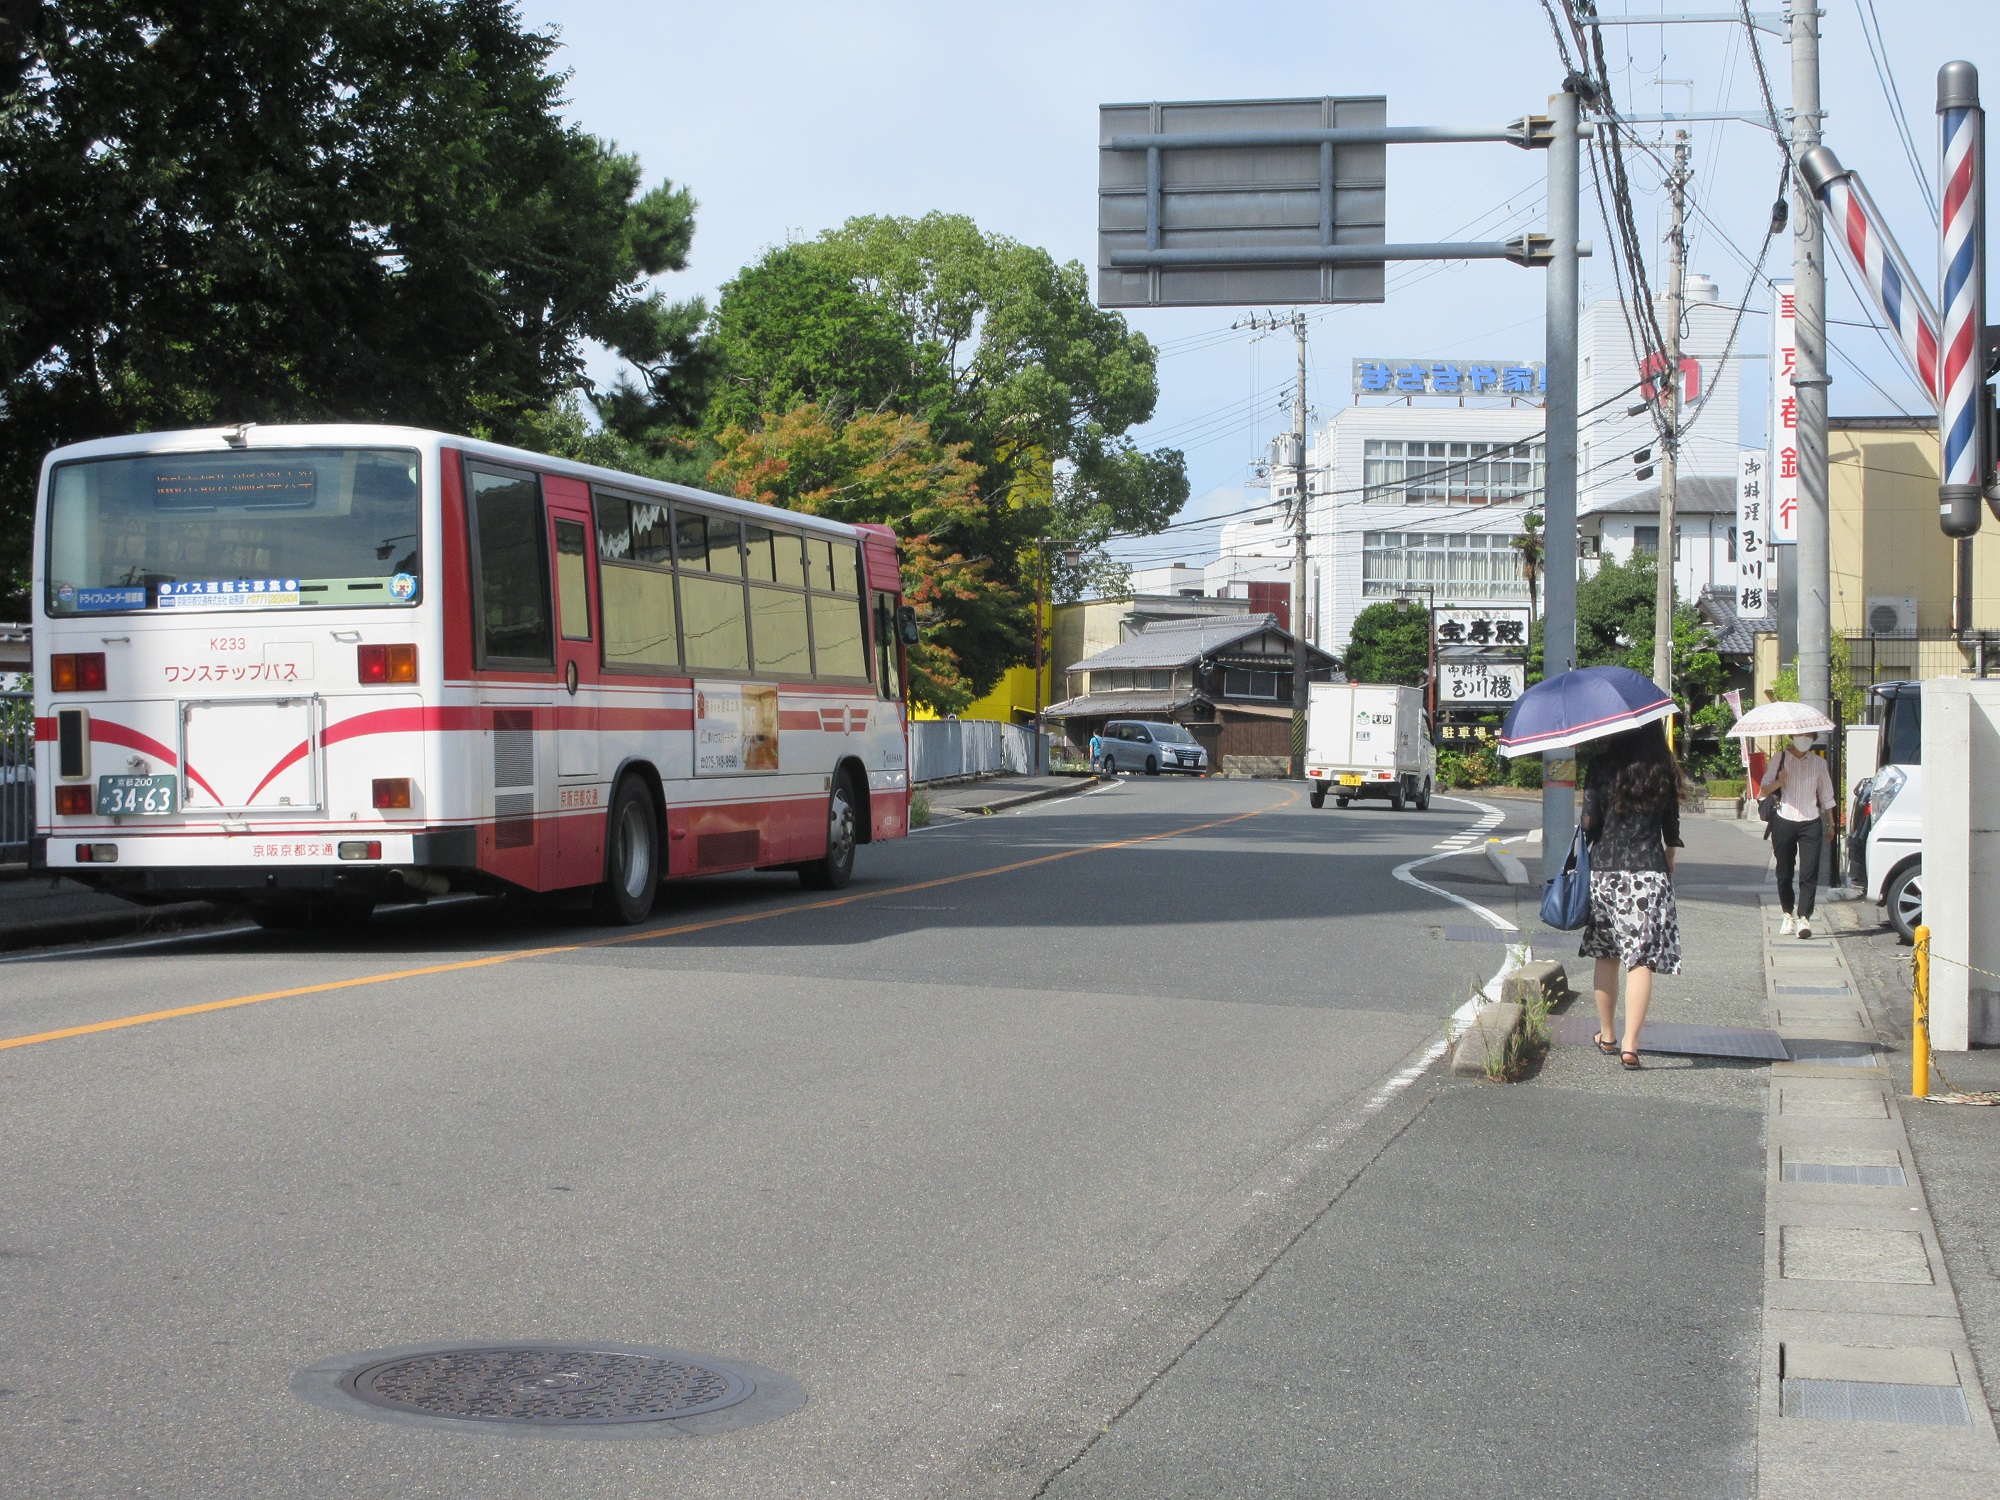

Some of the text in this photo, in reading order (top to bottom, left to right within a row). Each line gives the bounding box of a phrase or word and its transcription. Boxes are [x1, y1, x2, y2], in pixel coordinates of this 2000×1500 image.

[1360, 363, 1547, 392] まさきや家
[176, 580, 280, 593] バス運転士募集
[210, 638, 246, 651] K233
[164, 662, 299, 682] ワンステップバス
[1448, 664, 1488, 678] 御料理
[1442, 726, 1487, 740] 駐車場
[110, 787, 171, 812] 34-63
[560, 788, 599, 808] 京阪京都交通
[252, 843, 334, 858] 京阪京都交通
